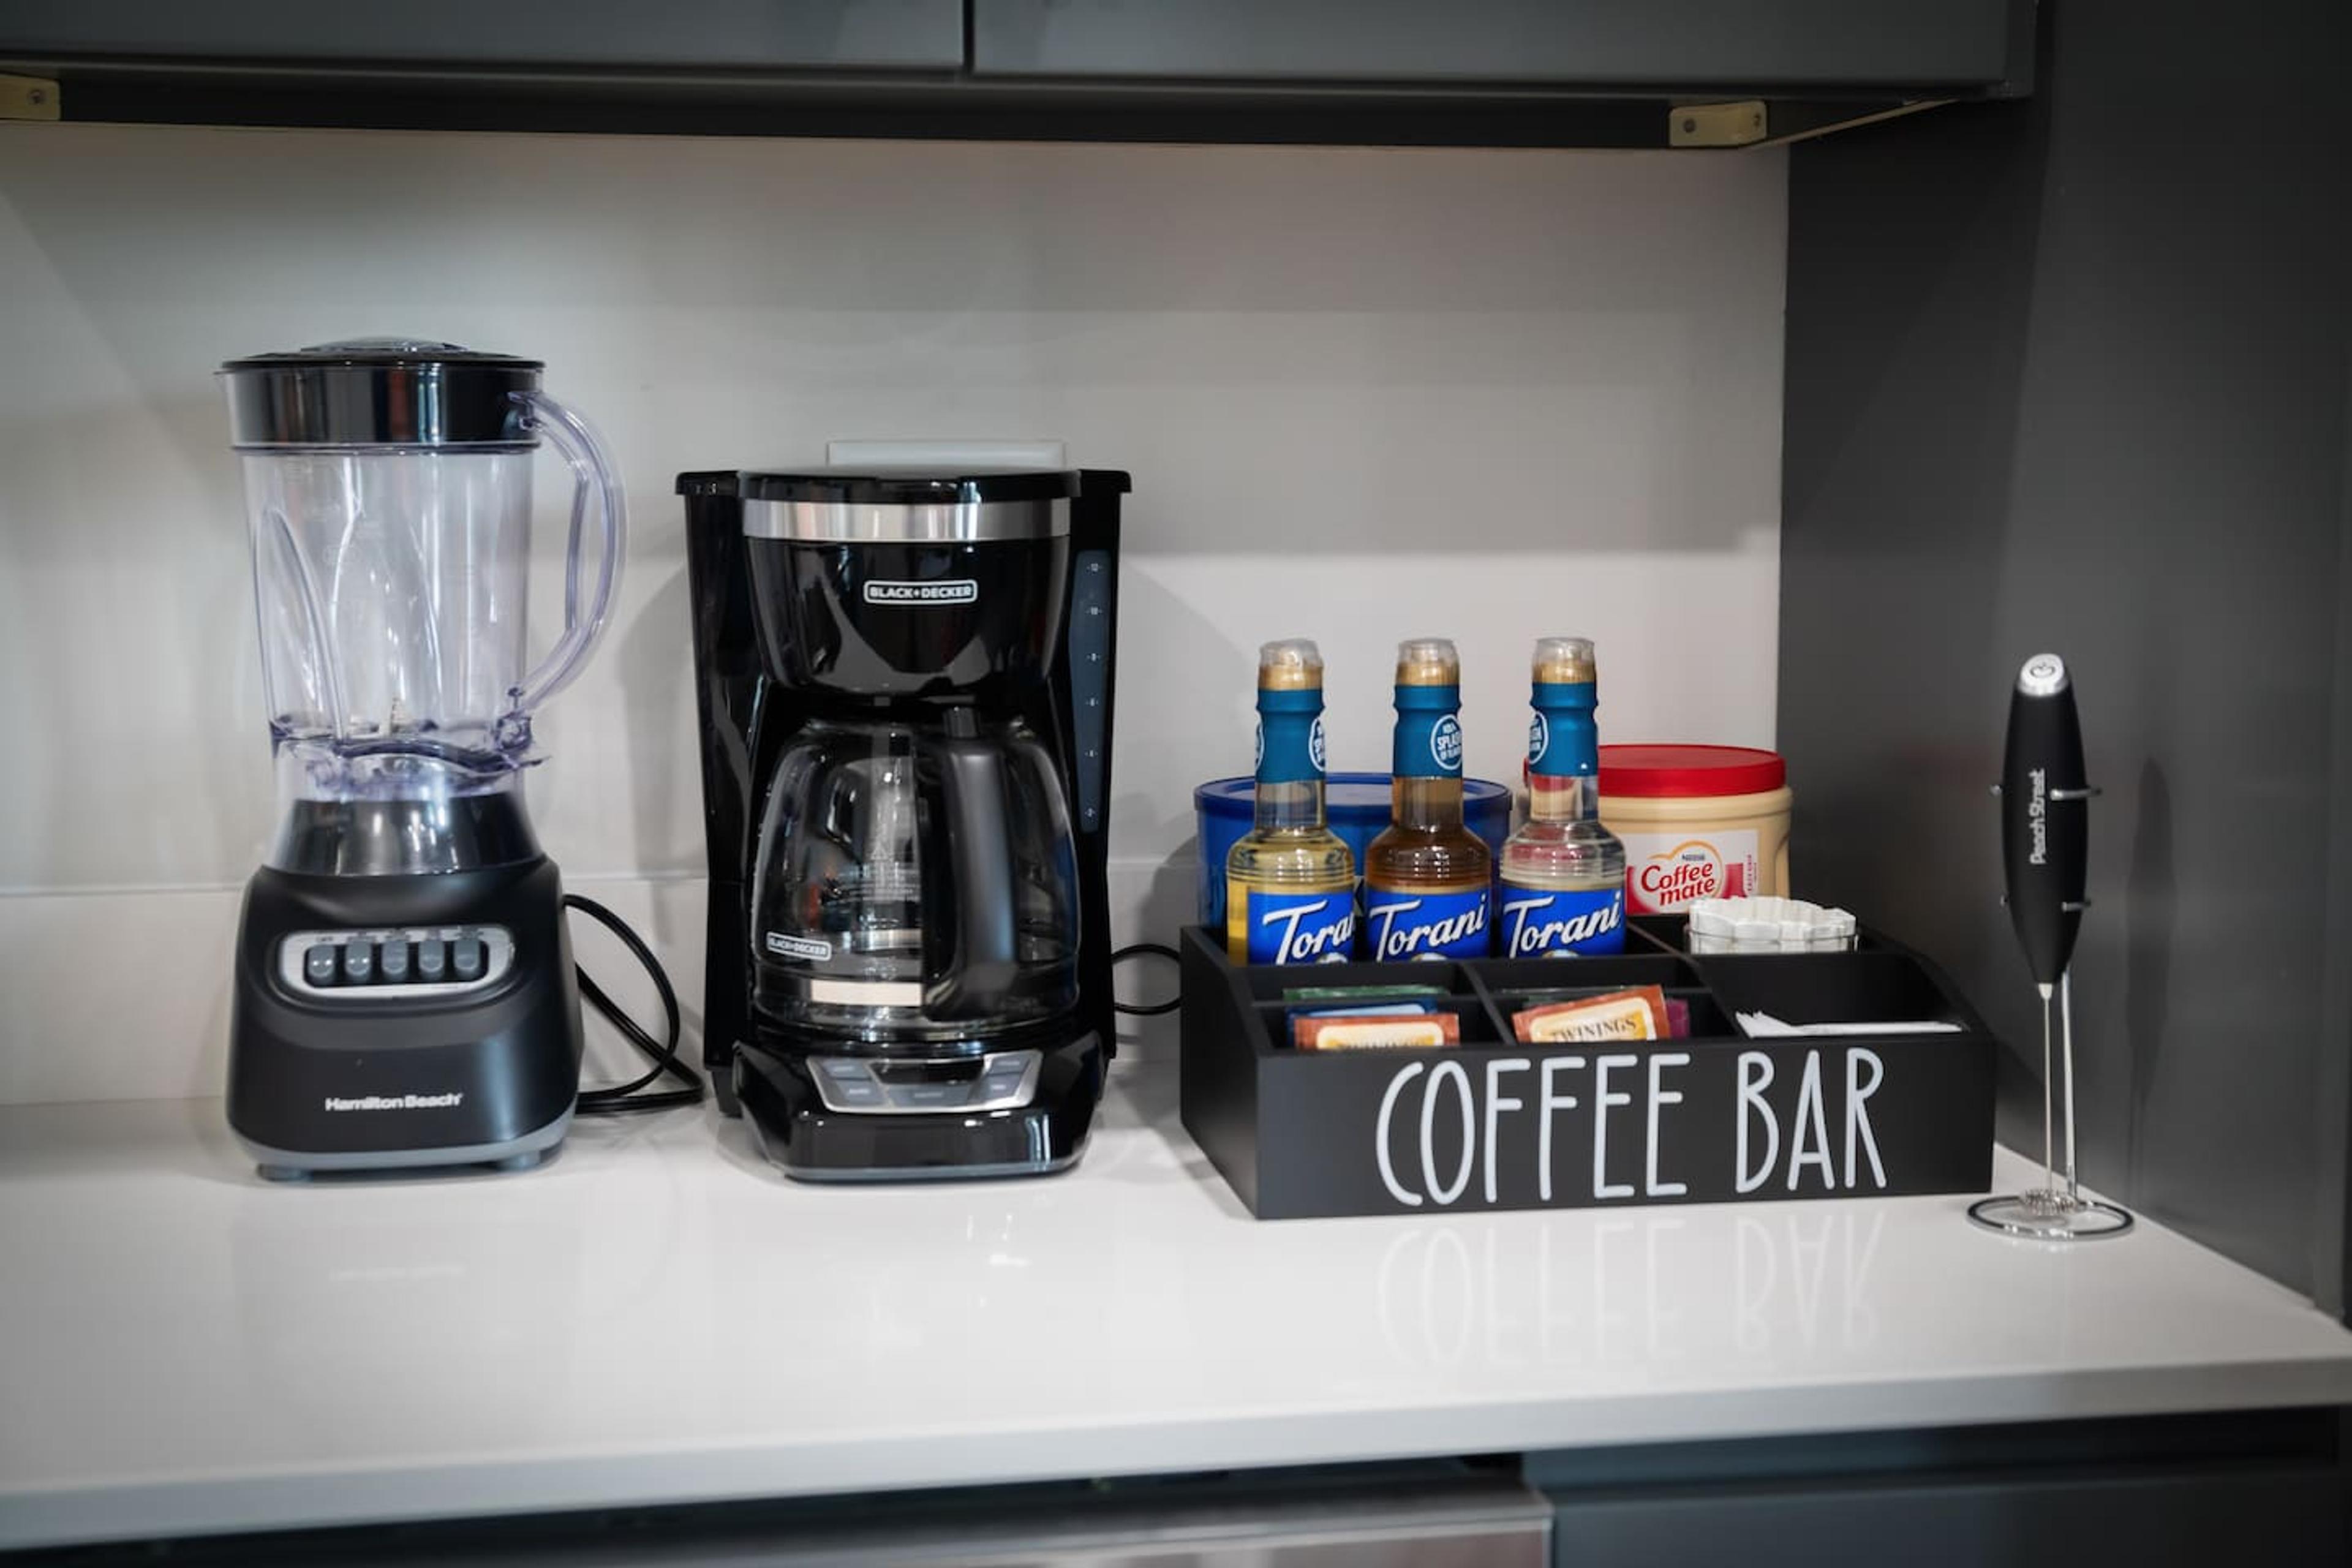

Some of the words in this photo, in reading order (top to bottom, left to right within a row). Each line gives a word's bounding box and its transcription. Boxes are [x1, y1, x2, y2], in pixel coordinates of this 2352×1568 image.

[870, 586, 972, 598] BLACK+DECKER
[2029, 767, 2045, 818] Street
[2029, 817, 2046, 865] Peach
[1640, 862, 1714, 892] Coffee
[1659, 878, 1716, 906] mate
[1368, 893, 1487, 963] Torani
[1503, 890, 1621, 960] Torani
[1548, 1017, 1637, 1041] TWININGS
[325, 1096, 404, 1111] Hamilton
[405, 1093, 460, 1108] Beach
[1376, 1053, 1691, 1207] COFFEE
[1735, 1047, 1887, 1193] BAR
